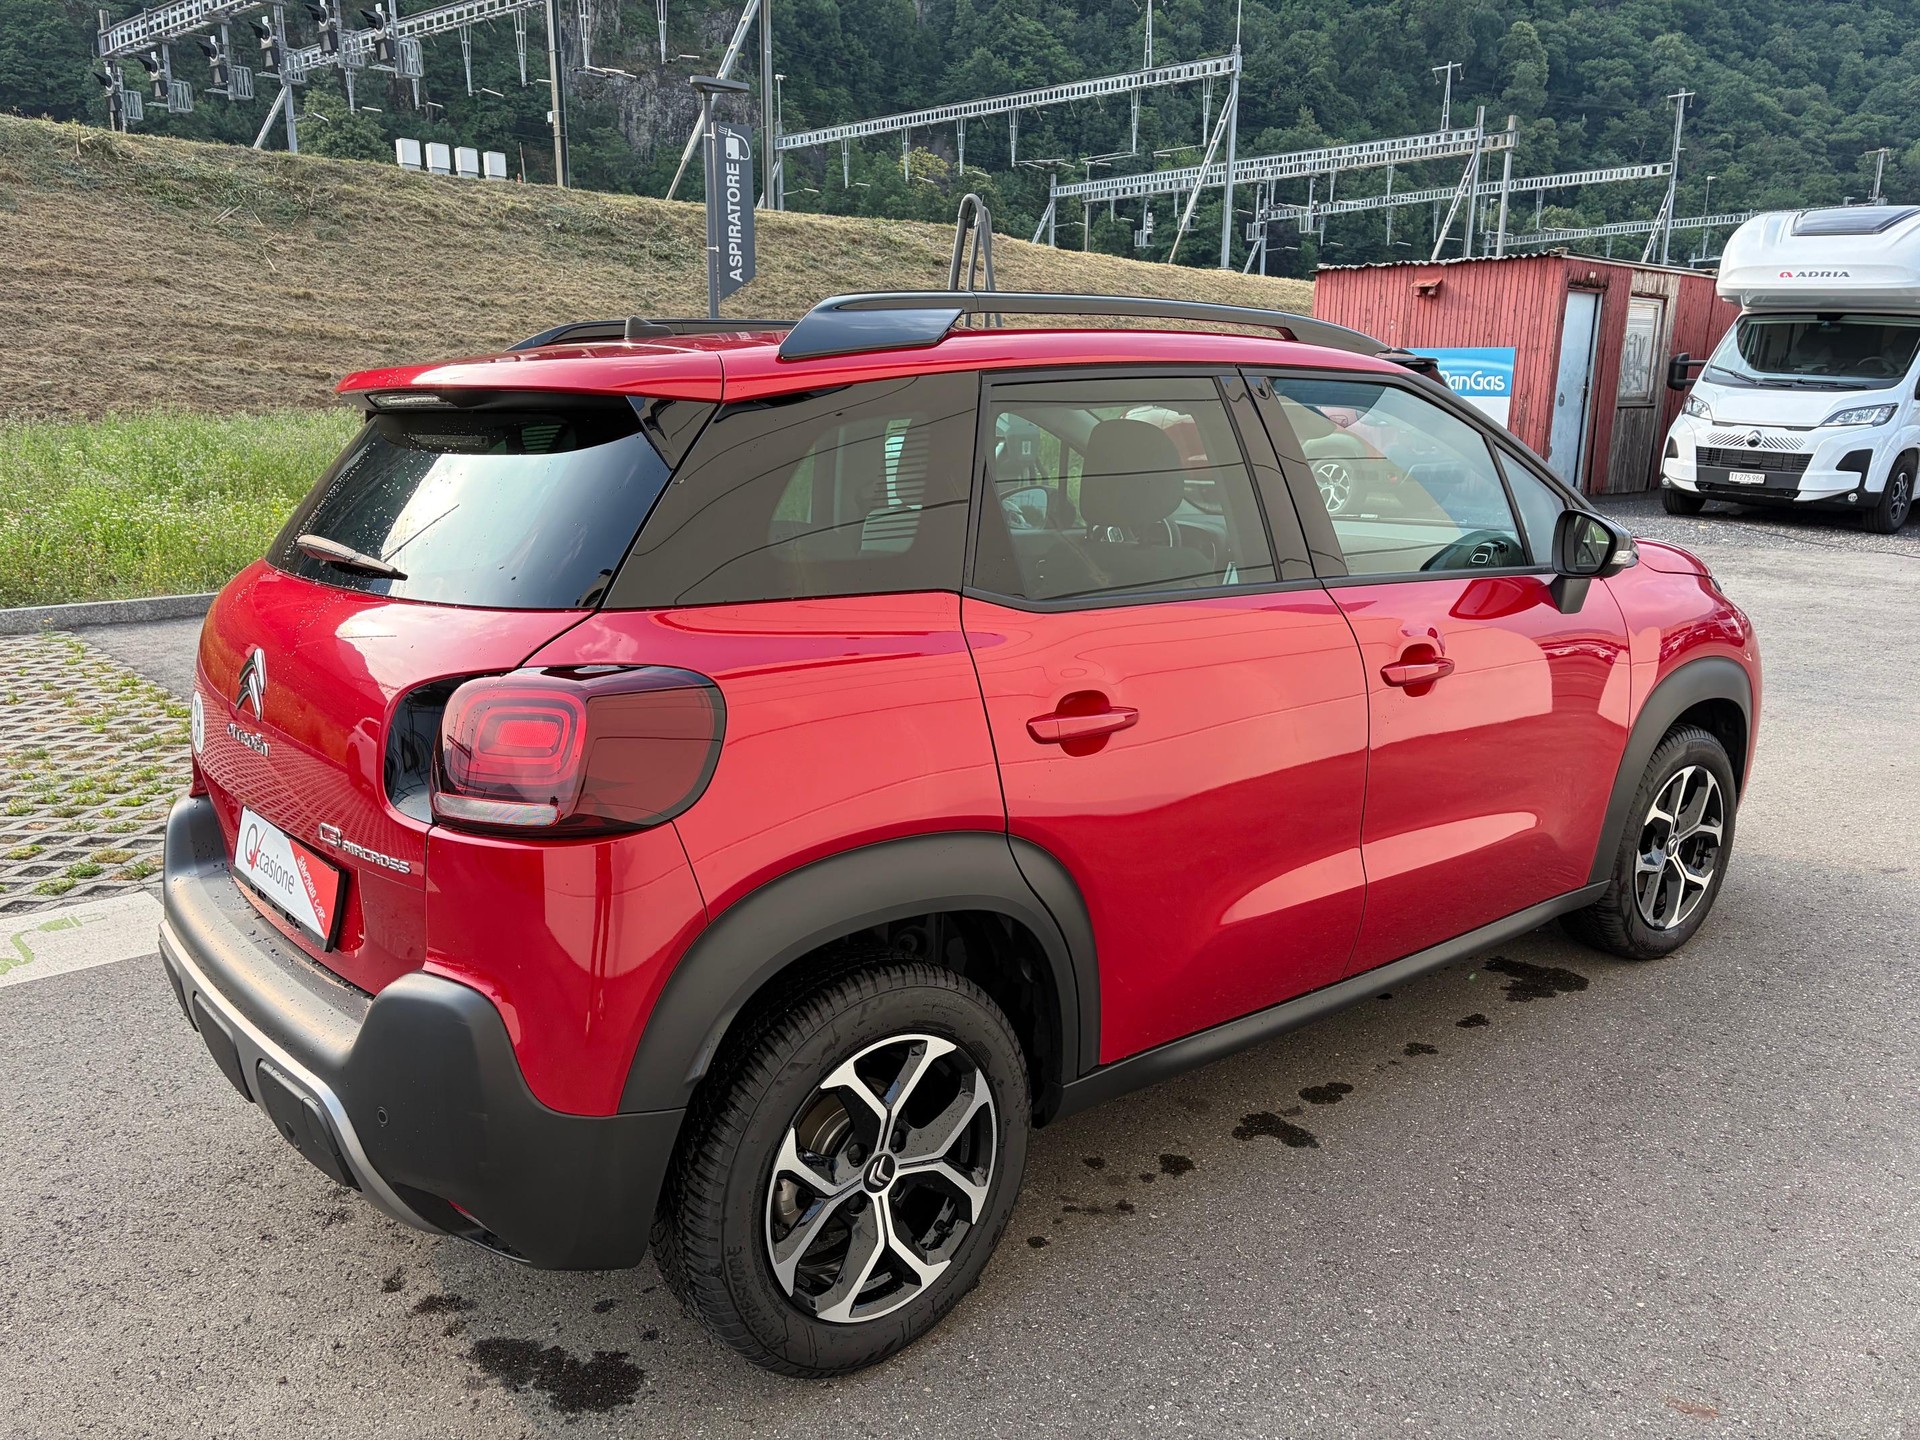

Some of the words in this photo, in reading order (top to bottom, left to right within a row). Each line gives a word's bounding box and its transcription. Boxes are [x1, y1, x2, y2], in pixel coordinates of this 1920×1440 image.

[726, 162, 743, 282] ASPIRATORE
[320, 822, 342, 847] C3
[342, 839, 411, 874] AIRCROSS
